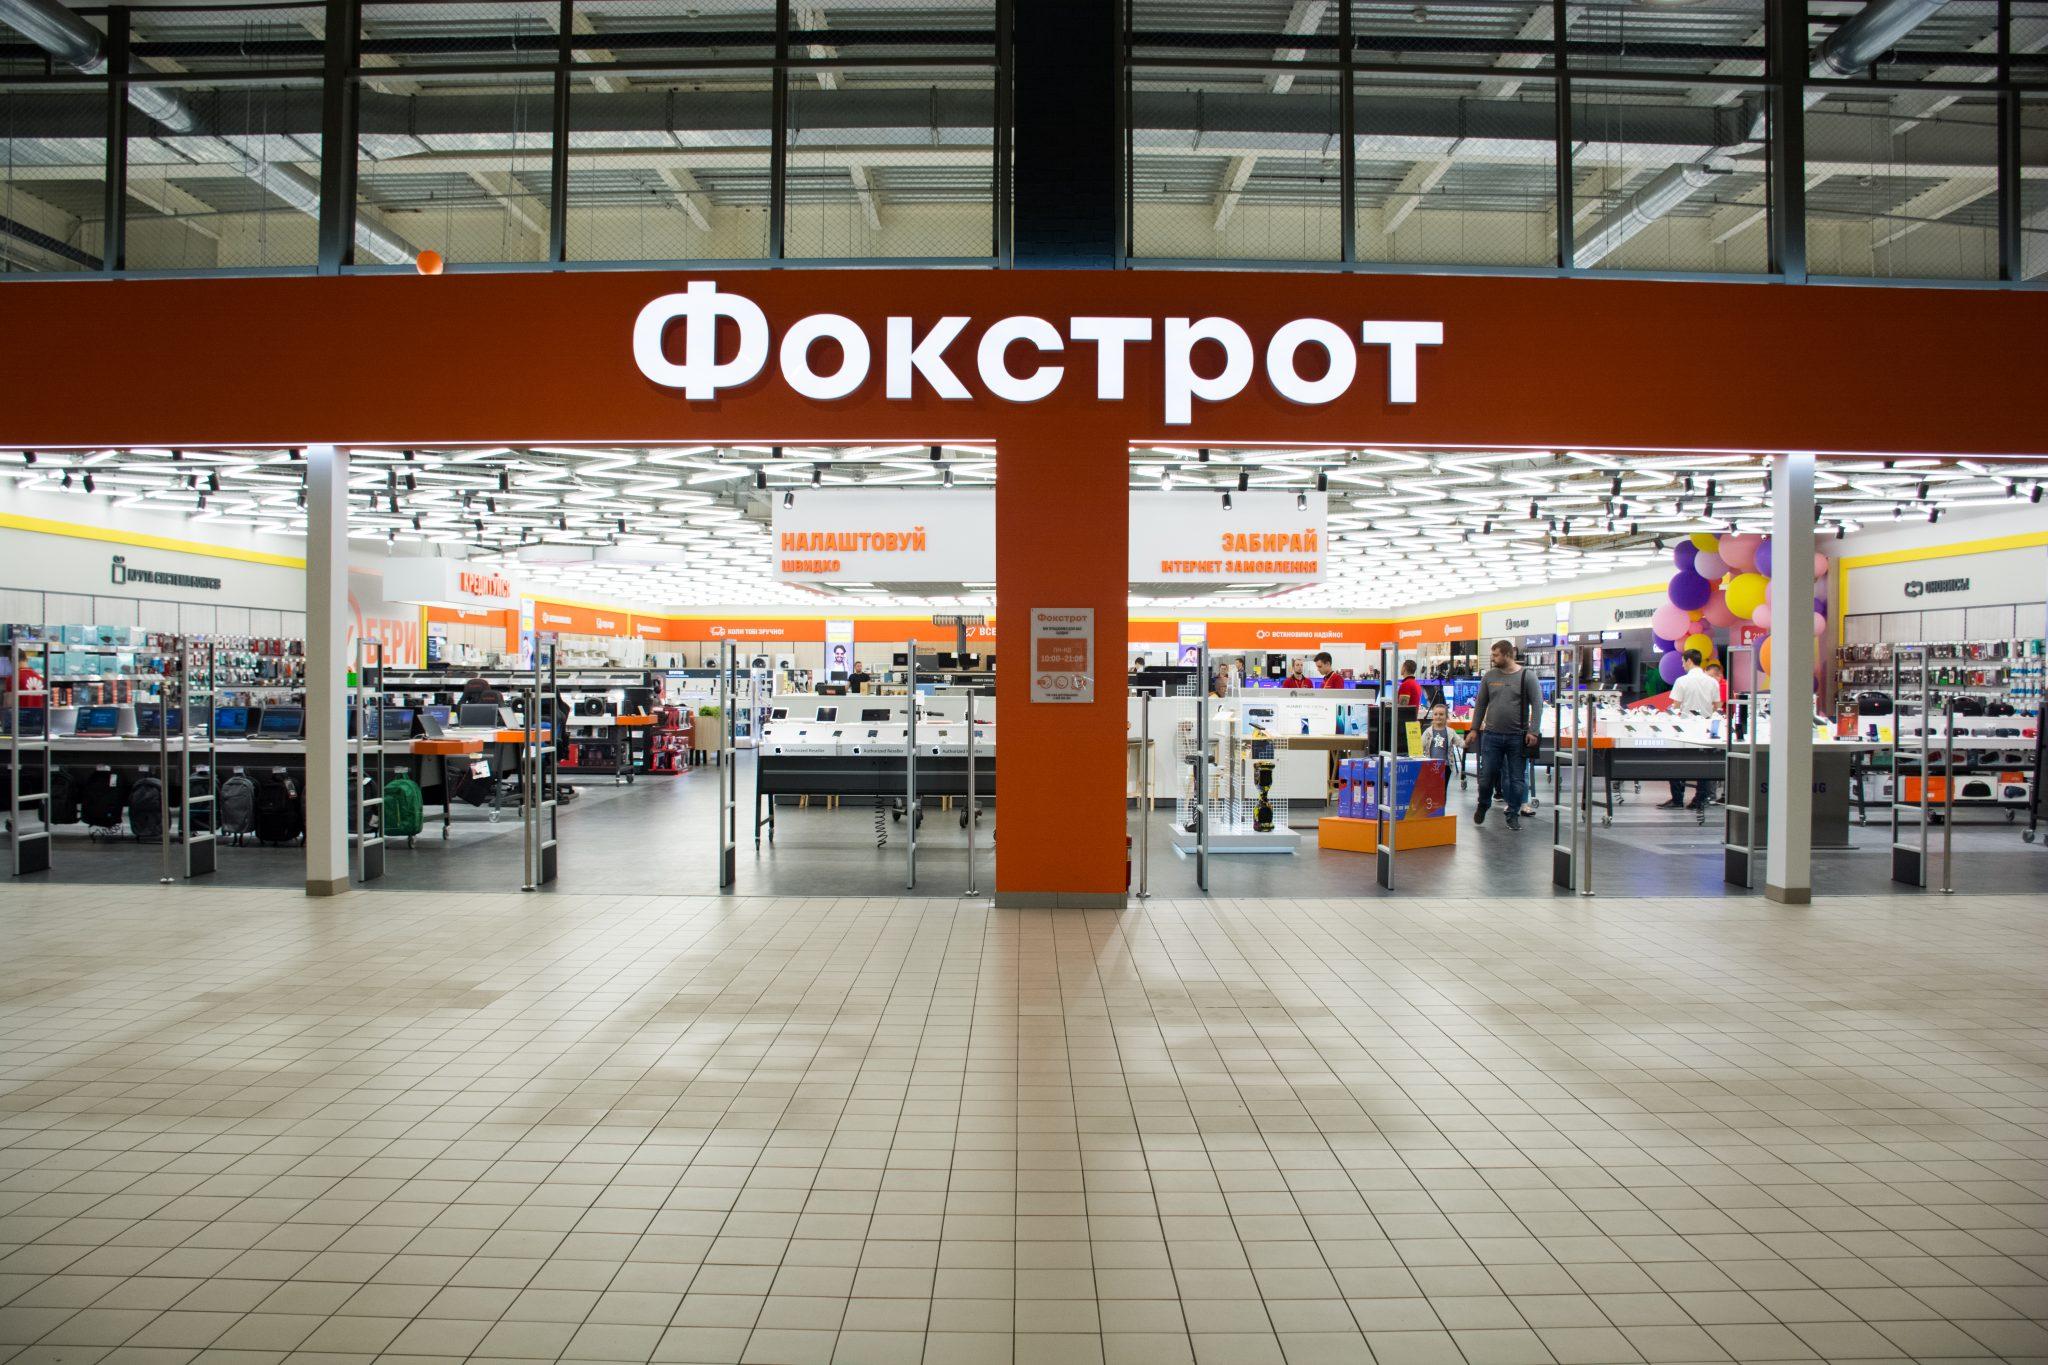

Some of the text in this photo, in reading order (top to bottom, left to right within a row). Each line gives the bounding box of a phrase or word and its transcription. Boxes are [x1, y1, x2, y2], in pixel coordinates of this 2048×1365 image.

[632, 280, 1444, 425] Фокстрот
[781, 526, 926, 552] НАЛАШТОВУЙ
[1221, 528, 1318, 553] ЗАБИРАЙ
[781, 559, 841, 574] ШВИДКО
[1161, 560, 1318, 574] ІНТЕРНЕТ ЗАМОВЛЕННЯ
[1037, 613, 1088, 623] Фокстрот
[1271, 630, 1313, 639] ВСТАНОВИМО
